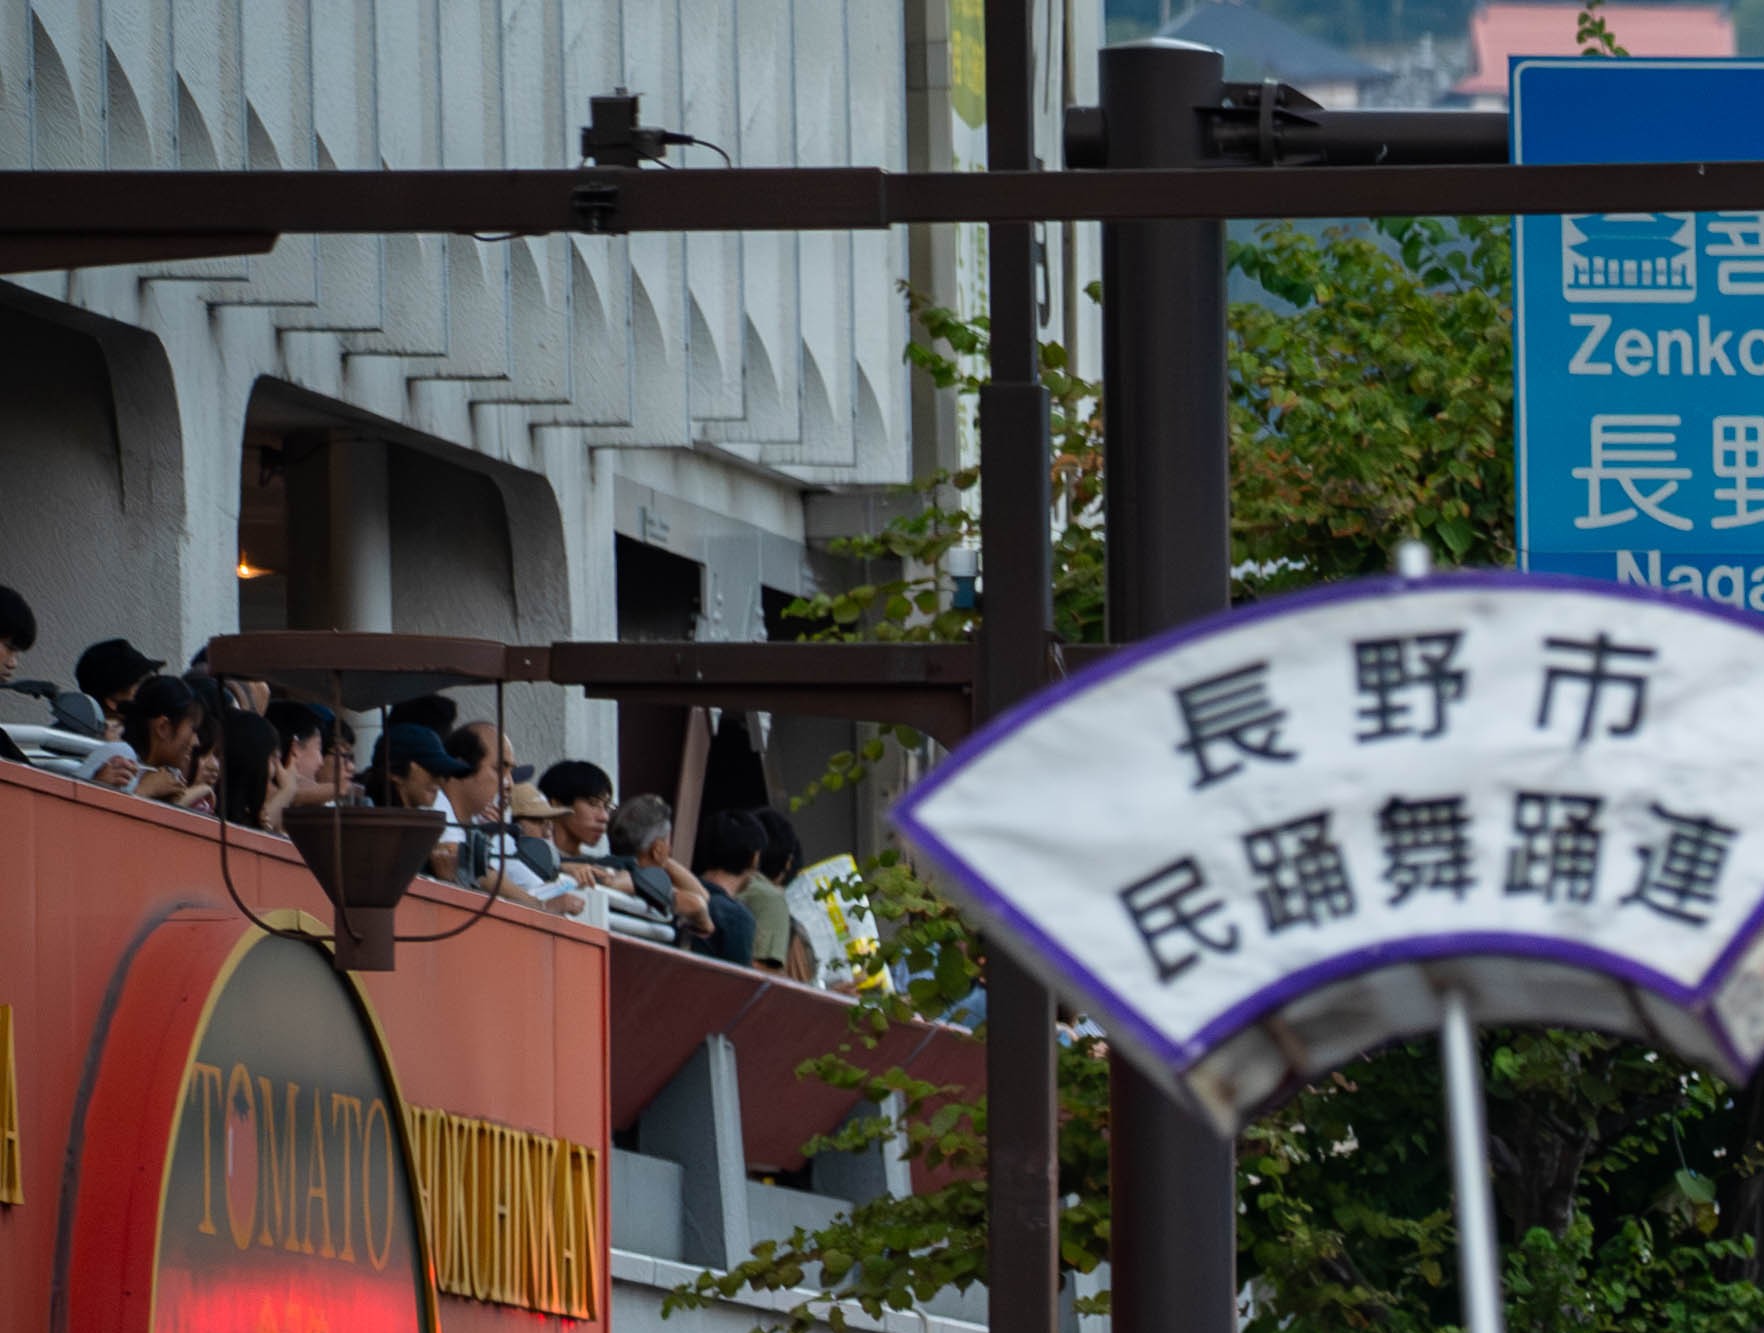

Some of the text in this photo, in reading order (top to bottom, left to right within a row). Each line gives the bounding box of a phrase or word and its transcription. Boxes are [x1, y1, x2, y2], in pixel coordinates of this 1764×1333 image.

[1171, 628, 1660, 793] 長野市
[1119, 790, 1742, 984] 民踊舞踊連
[193, 1061, 396, 1271] TOMATO
